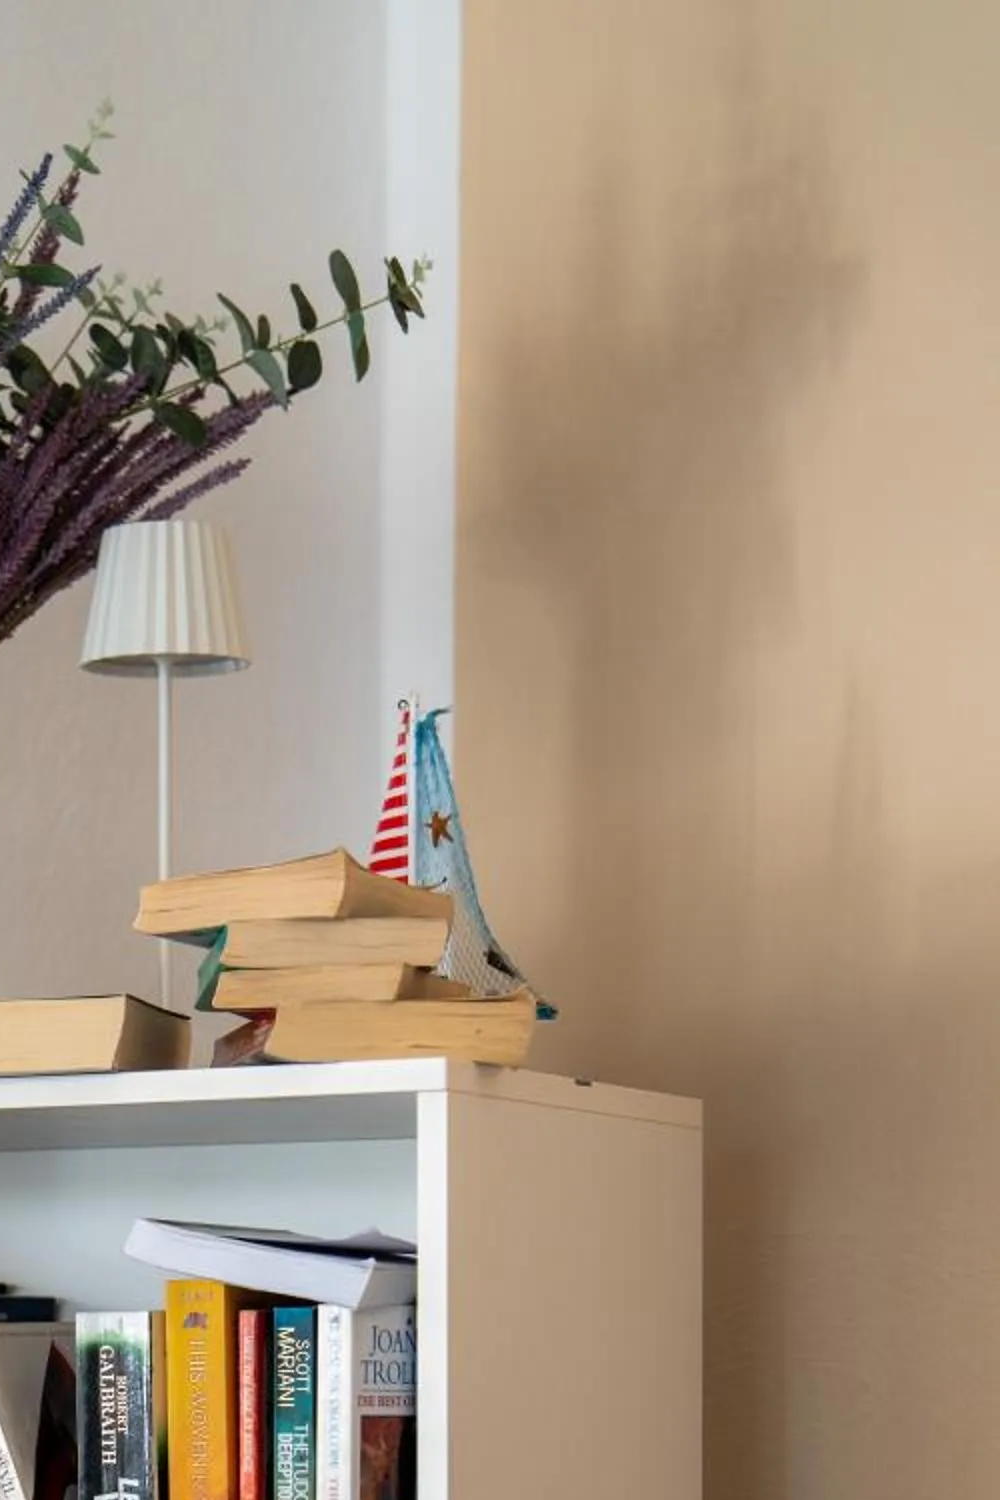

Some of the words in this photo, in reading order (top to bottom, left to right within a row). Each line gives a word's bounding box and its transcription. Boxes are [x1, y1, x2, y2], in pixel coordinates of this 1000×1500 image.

[187, 1339, 206, 1383] THIS
[276, 1326, 295, 1408] MARIANI
[294, 1338, 310, 1394] SCOTT
[98, 1345, 117, 1466] GALBRAITH
[115, 1375, 128, 1435] ROBERT
[293, 1423, 309, 1459] THE
